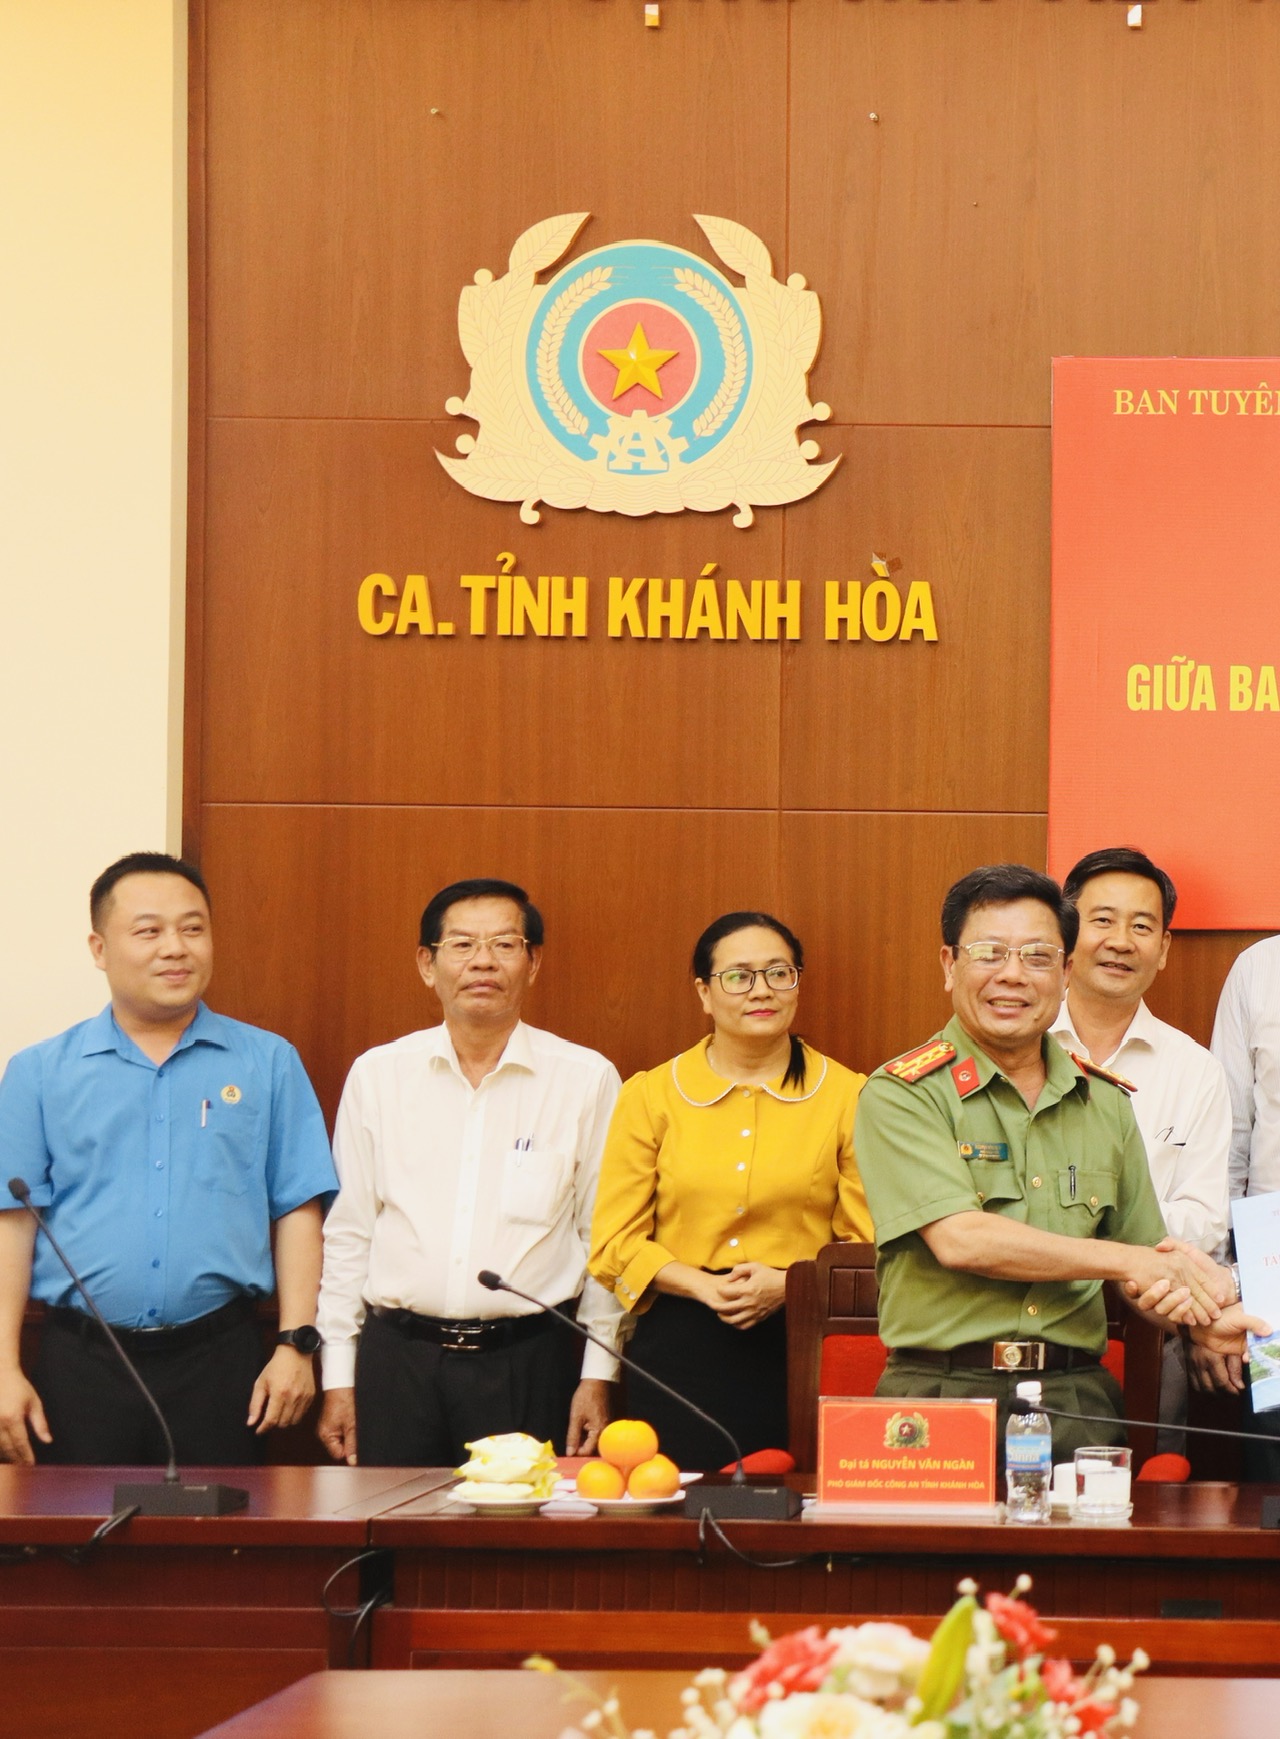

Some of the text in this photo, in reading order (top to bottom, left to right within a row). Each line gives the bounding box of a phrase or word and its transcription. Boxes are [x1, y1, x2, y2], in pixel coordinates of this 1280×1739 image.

[1113, 389, 1180, 415] BAN
[608, 563, 803, 641] KHÁNH
[825, 559, 939, 643] HÒA
[1126, 655, 1217, 712] GIỮA
[839, 1459, 857, 1471] Đại
[859, 1458, 870, 1469] tá
[871, 1456, 916, 1470] NGUYỄN
[943, 1458, 975, 1470] NGÀN
